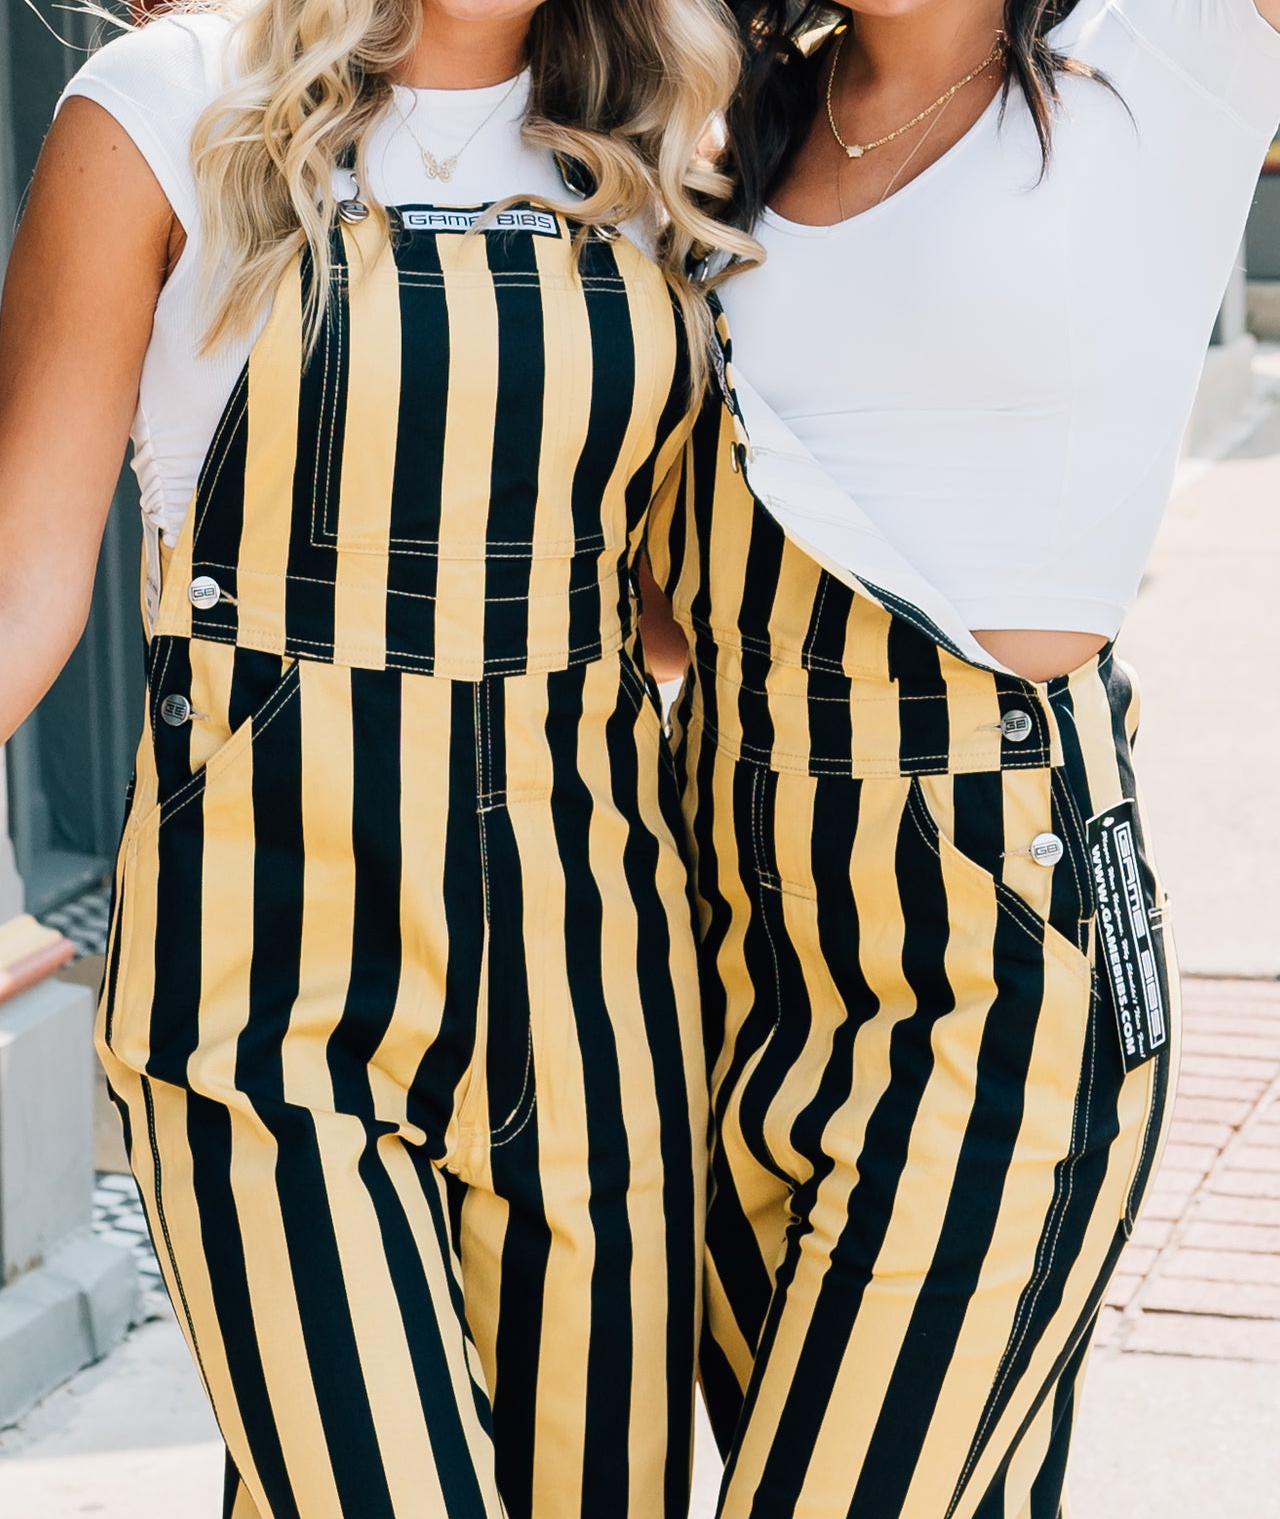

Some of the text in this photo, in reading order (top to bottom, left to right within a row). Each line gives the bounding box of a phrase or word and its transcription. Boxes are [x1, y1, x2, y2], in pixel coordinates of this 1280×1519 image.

[496, 213, 552, 229] BIBS
[192, 588, 216, 599] GB
[1005, 719, 1027, 731] GB
[1035, 844, 1059, 856] GB
[1117, 828, 1162, 1039] GAME BIBS
[1091, 843, 1137, 1056] WWW.GAMEBIBS.COM
